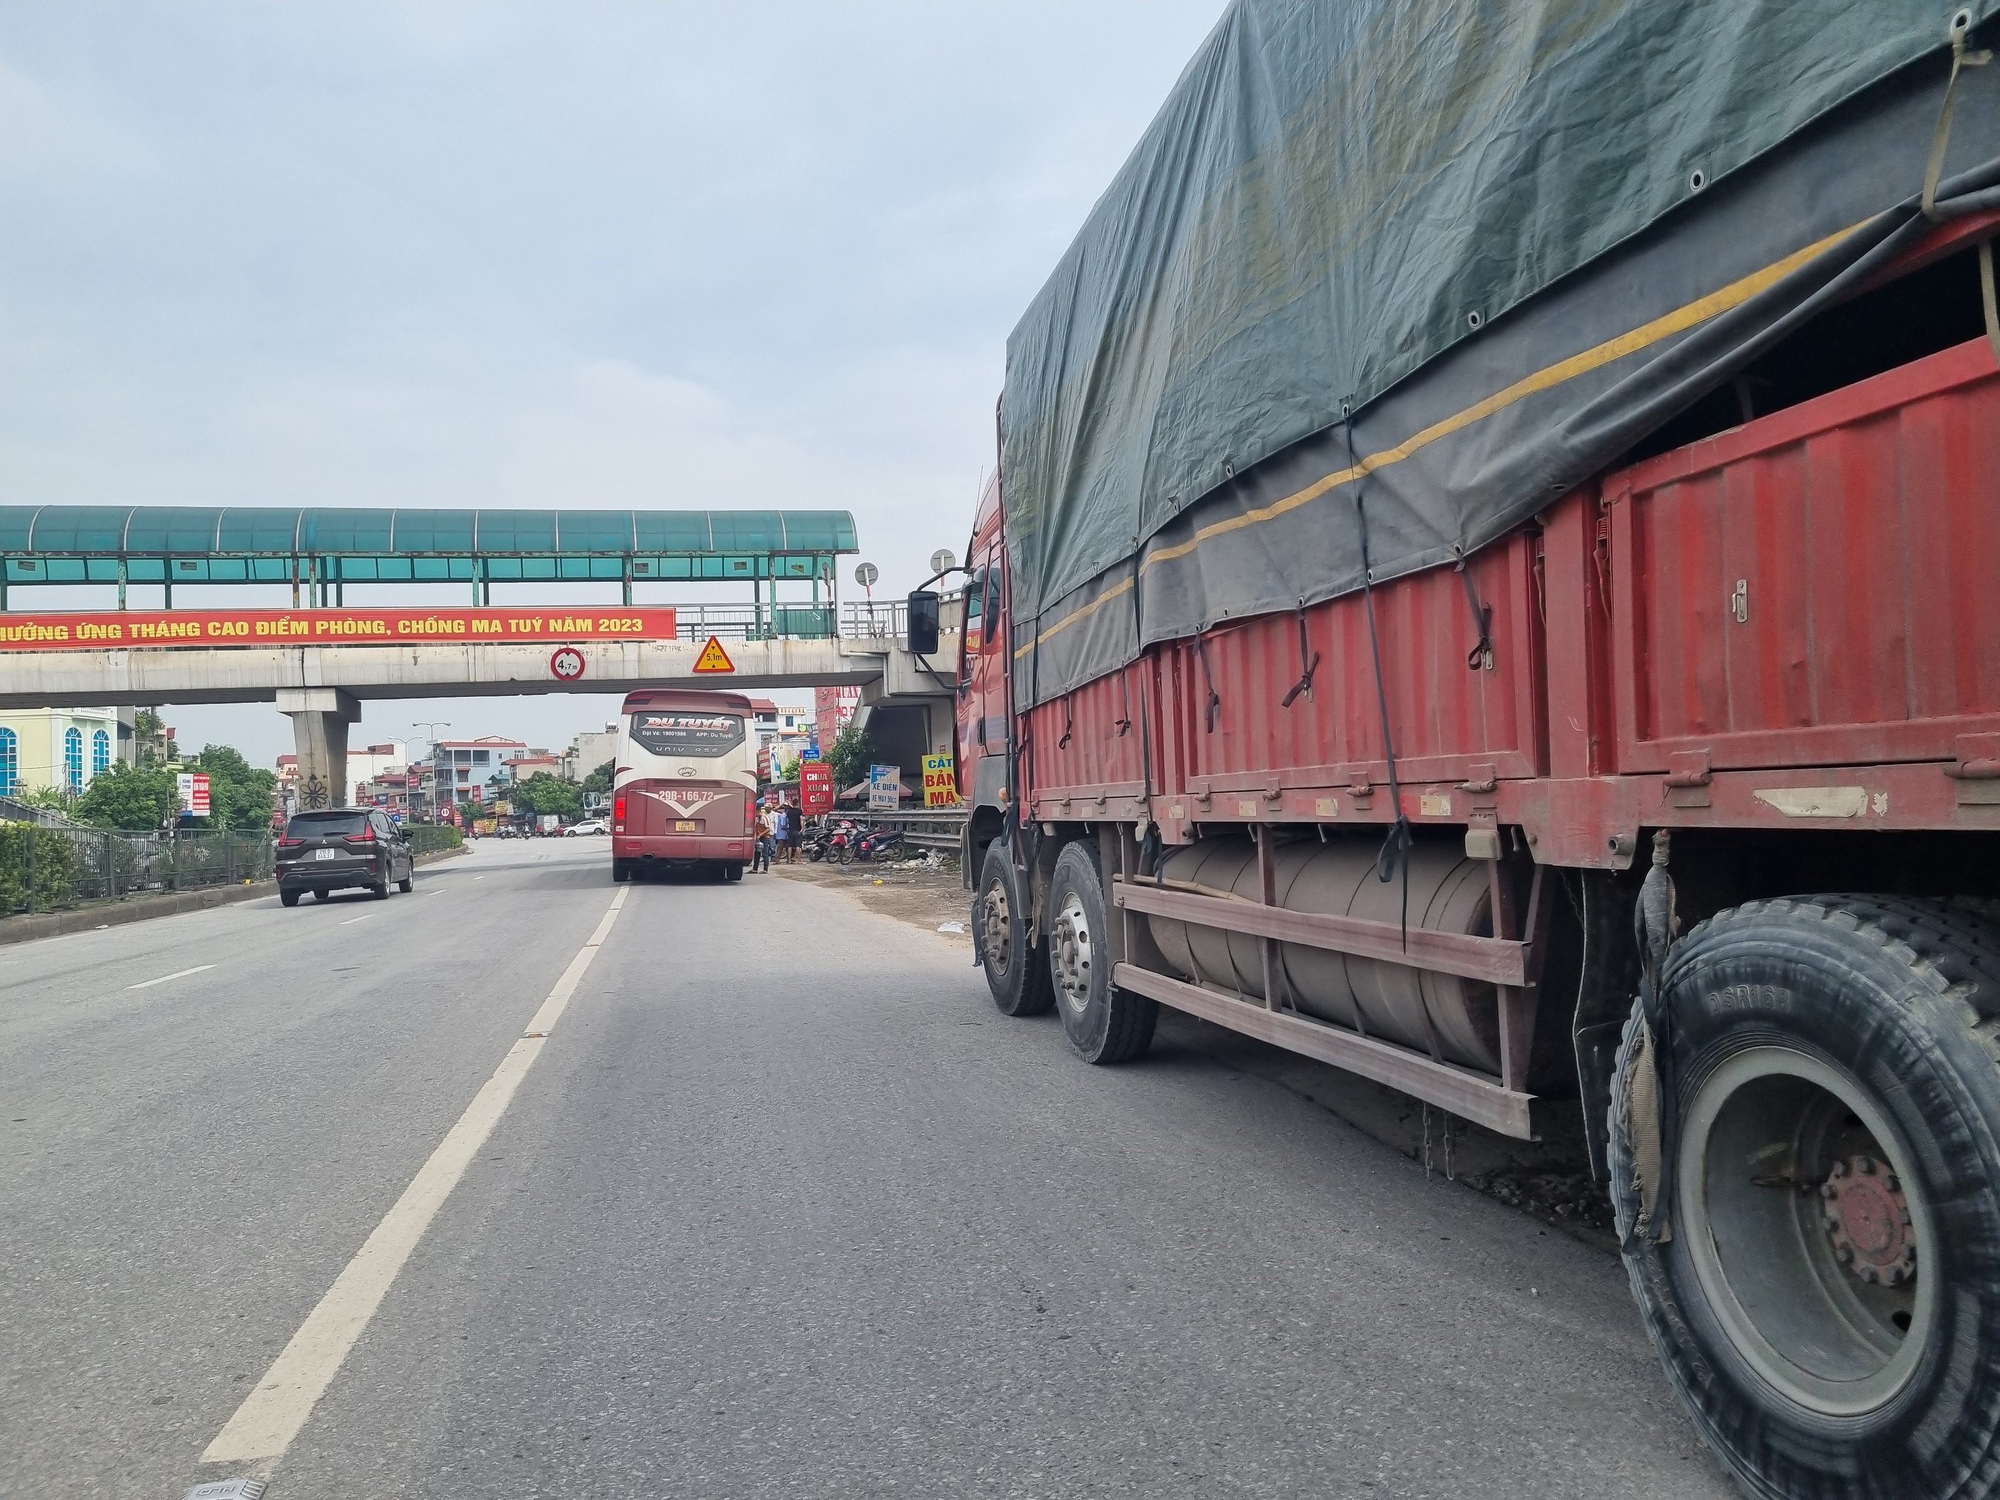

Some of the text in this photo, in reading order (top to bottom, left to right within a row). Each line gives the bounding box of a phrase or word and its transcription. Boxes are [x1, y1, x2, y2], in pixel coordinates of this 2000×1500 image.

[76, 622, 122, 640] ỨNG
[129, 620, 200, 638] THÁNG
[207, 621, 249, 636] CAO
[256, 616, 309, 635] ĐIỂM
[316, 618, 392, 636] PHÒNG,
[398, 615, 466, 634] CHỐNG
[471, 619, 503, 633] MA
[508, 616, 543, 632] TUÝ
[549, 616, 593, 632] NĂM
[598, 618, 643, 632] 2023
[659, 790, 714, 801] 29B-166.72
